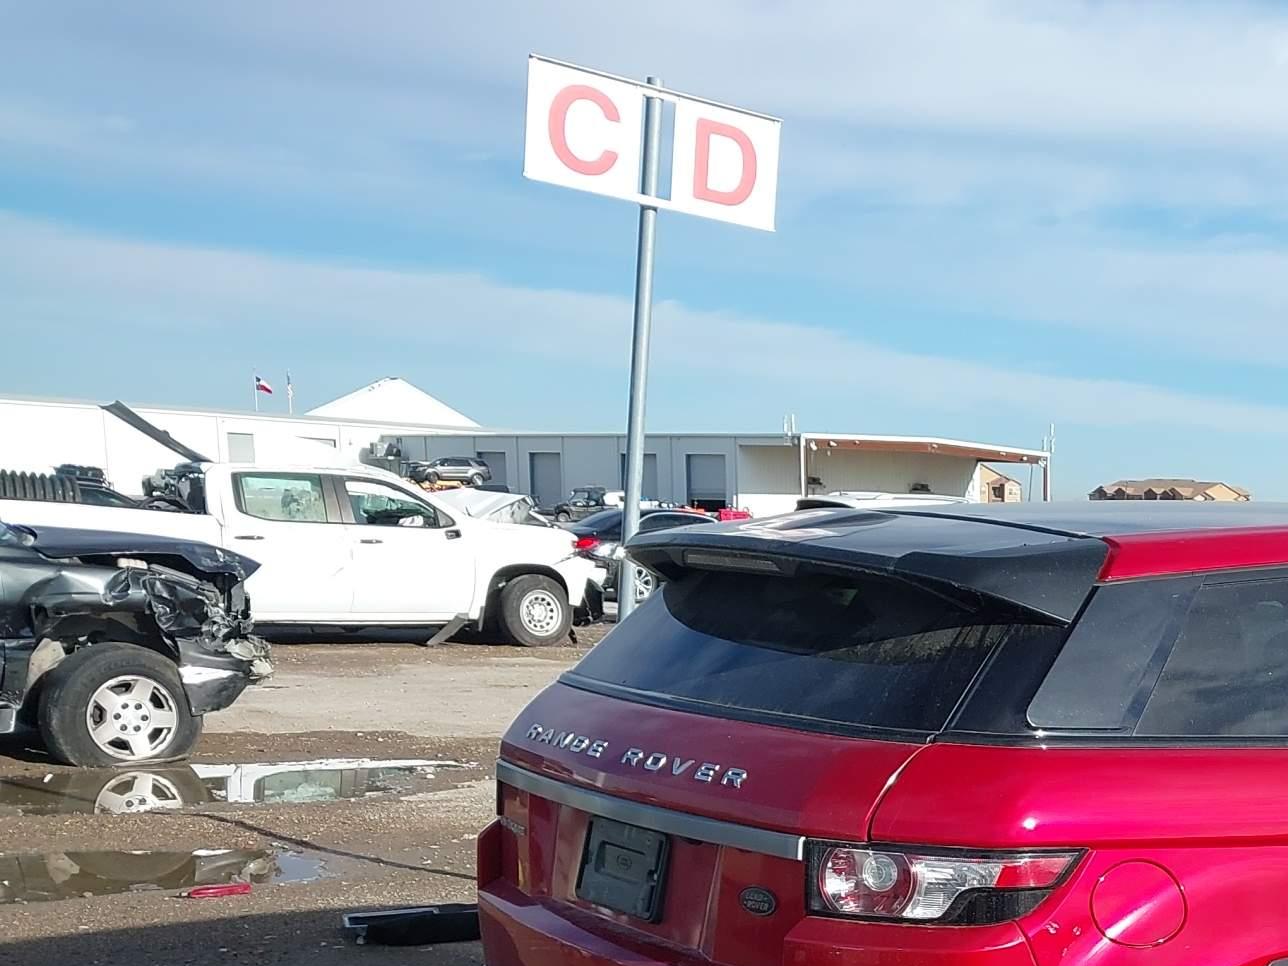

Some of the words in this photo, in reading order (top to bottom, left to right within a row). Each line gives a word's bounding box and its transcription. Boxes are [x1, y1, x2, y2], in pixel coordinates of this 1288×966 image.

[548, 84, 621, 176] C
[693, 117, 757, 206] D
[526, 723, 609, 758] RANGE
[620, 747, 748, 788] ROVER
